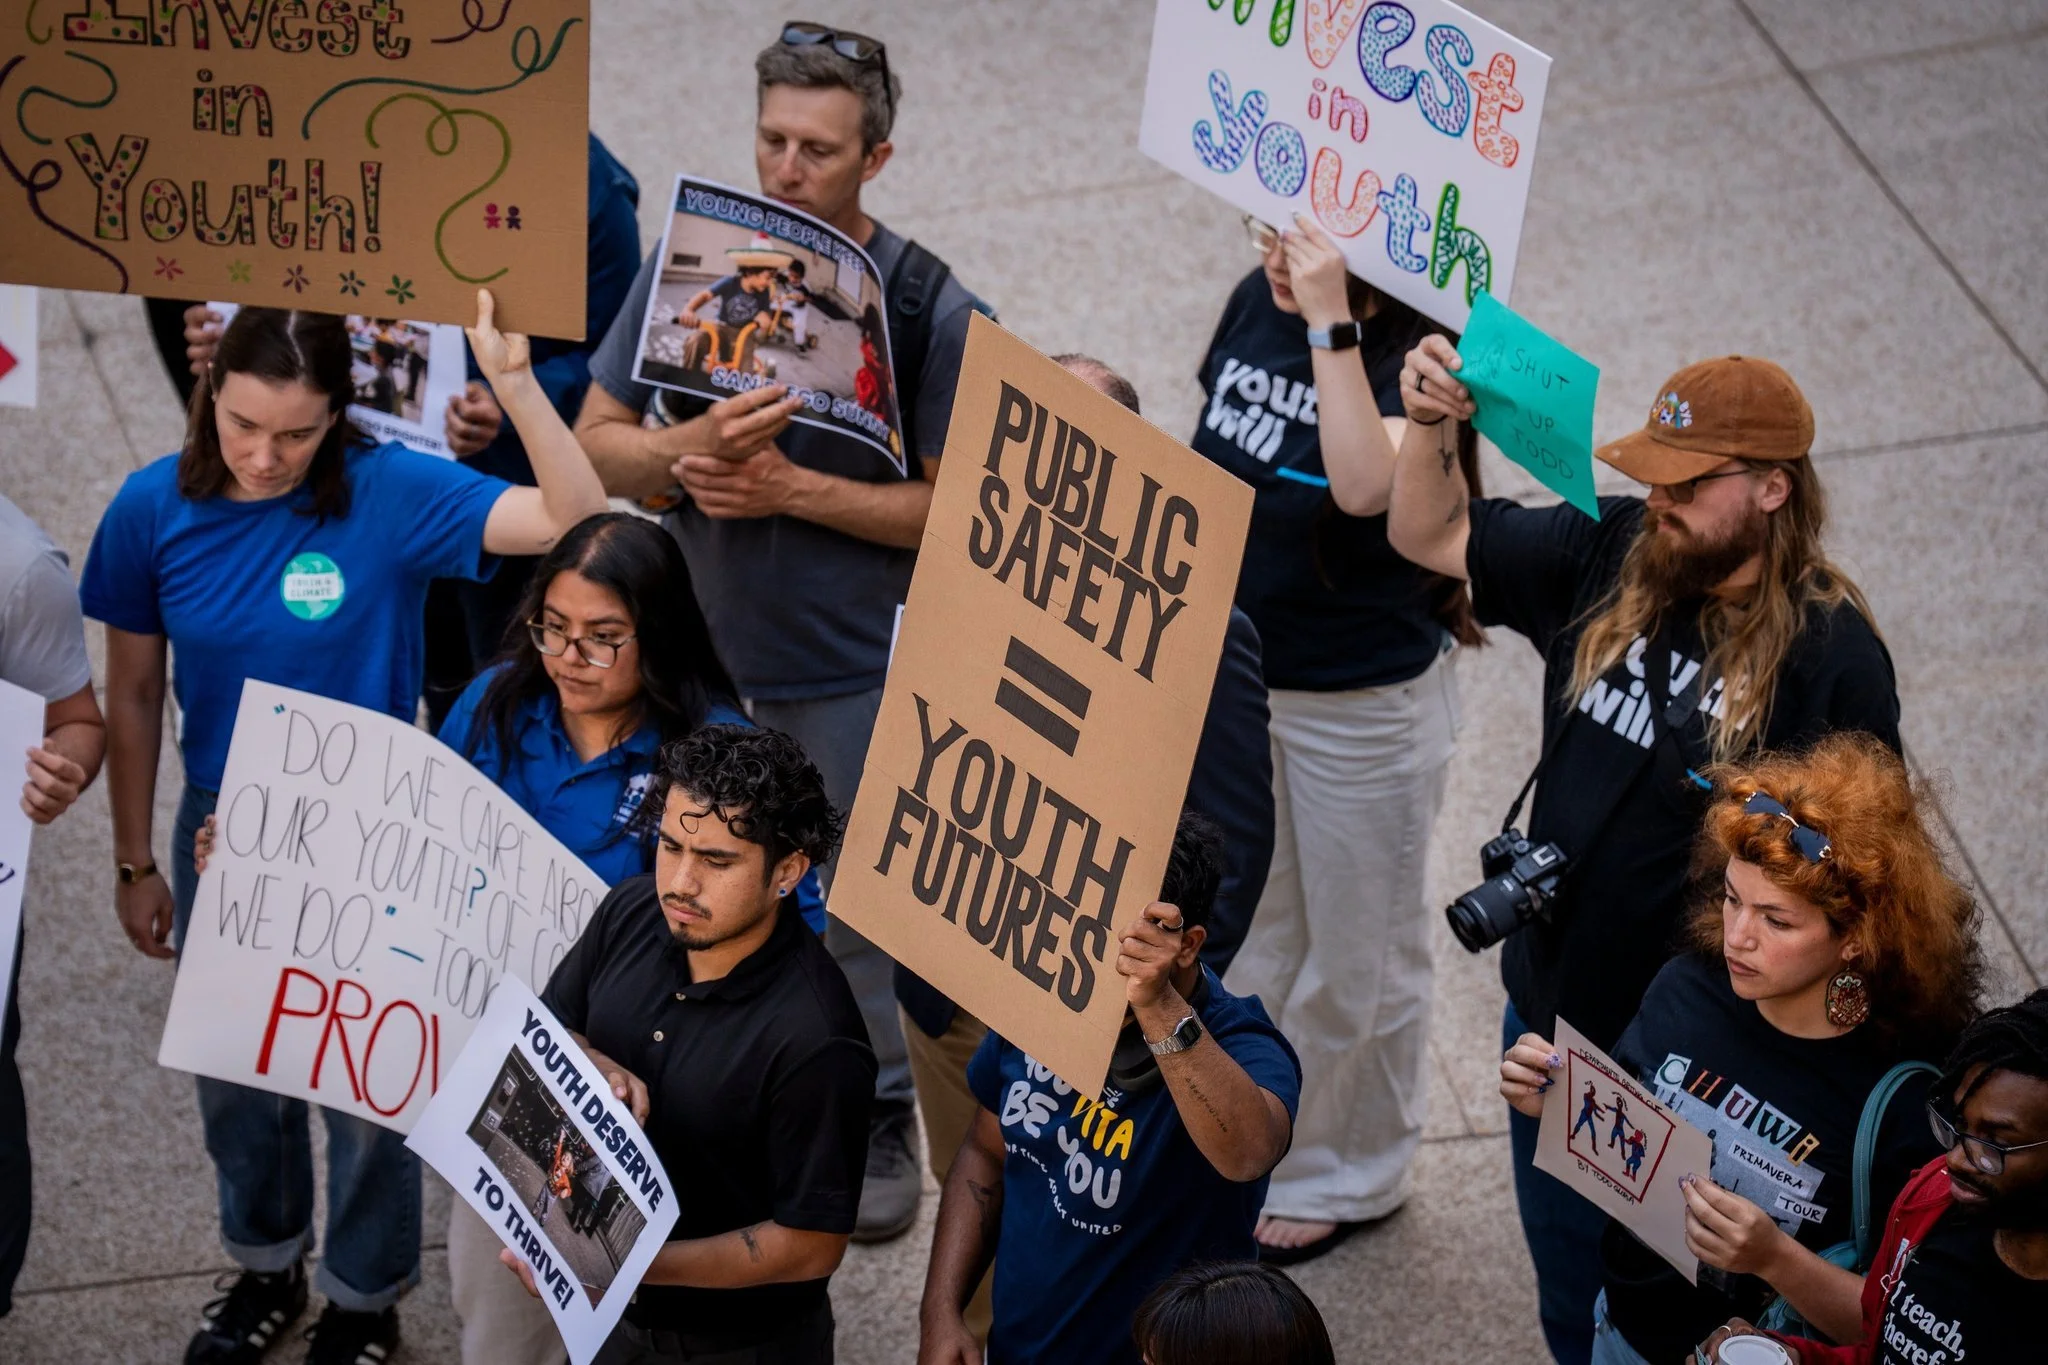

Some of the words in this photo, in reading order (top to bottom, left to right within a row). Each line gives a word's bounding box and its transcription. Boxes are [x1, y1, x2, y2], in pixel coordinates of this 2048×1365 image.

[193, 69, 273, 137] in
[1308, 78, 1369, 143] in
[66, 133, 382, 254] Youth!
[684, 187, 765, 227] YOUNG
[764, 211, 832, 256] PEOPLE
[1510, 348, 1570, 392] SHUT
[1528, 409, 1555, 433] UP
[982, 379, 1199, 596] PUBLIC
[968, 474, 1188, 683] SAFETY
[384, 735, 446, 832] WE
[460, 785, 532, 900] CARE
[910, 692, 1137, 931] YOUTH
[219, 870, 281, 952] WE
[226, 783, 330, 867] OUR
[354, 809, 487, 929] YOUTH?
[486, 891, 532, 973] OF
[873, 785, 1109, 1014] FUTURES
[521, 1007, 591, 1107] YOUTH
[581, 1093, 665, 1213] DESERVE
[1001, 1080, 1060, 1139] BE
[1048, 1177, 1058, 1195] TO
[1053, 1195, 1068, 1220] ACT
[1071, 1217, 1122, 1235] UNITED
[1057, 1125, 1122, 1209] YOU
[1577, 1158, 1589, 1174] BY
[1732, 1143, 1803, 1190] PRIMAVERA
[473, 1166, 505, 1212] TO
[505, 1203, 576, 1311] THRIVE!
[1779, 1195, 1822, 1222] TOUR
[1889, 1280, 1907, 1307] I
[1900, 1293, 1966, 1362] teach,
